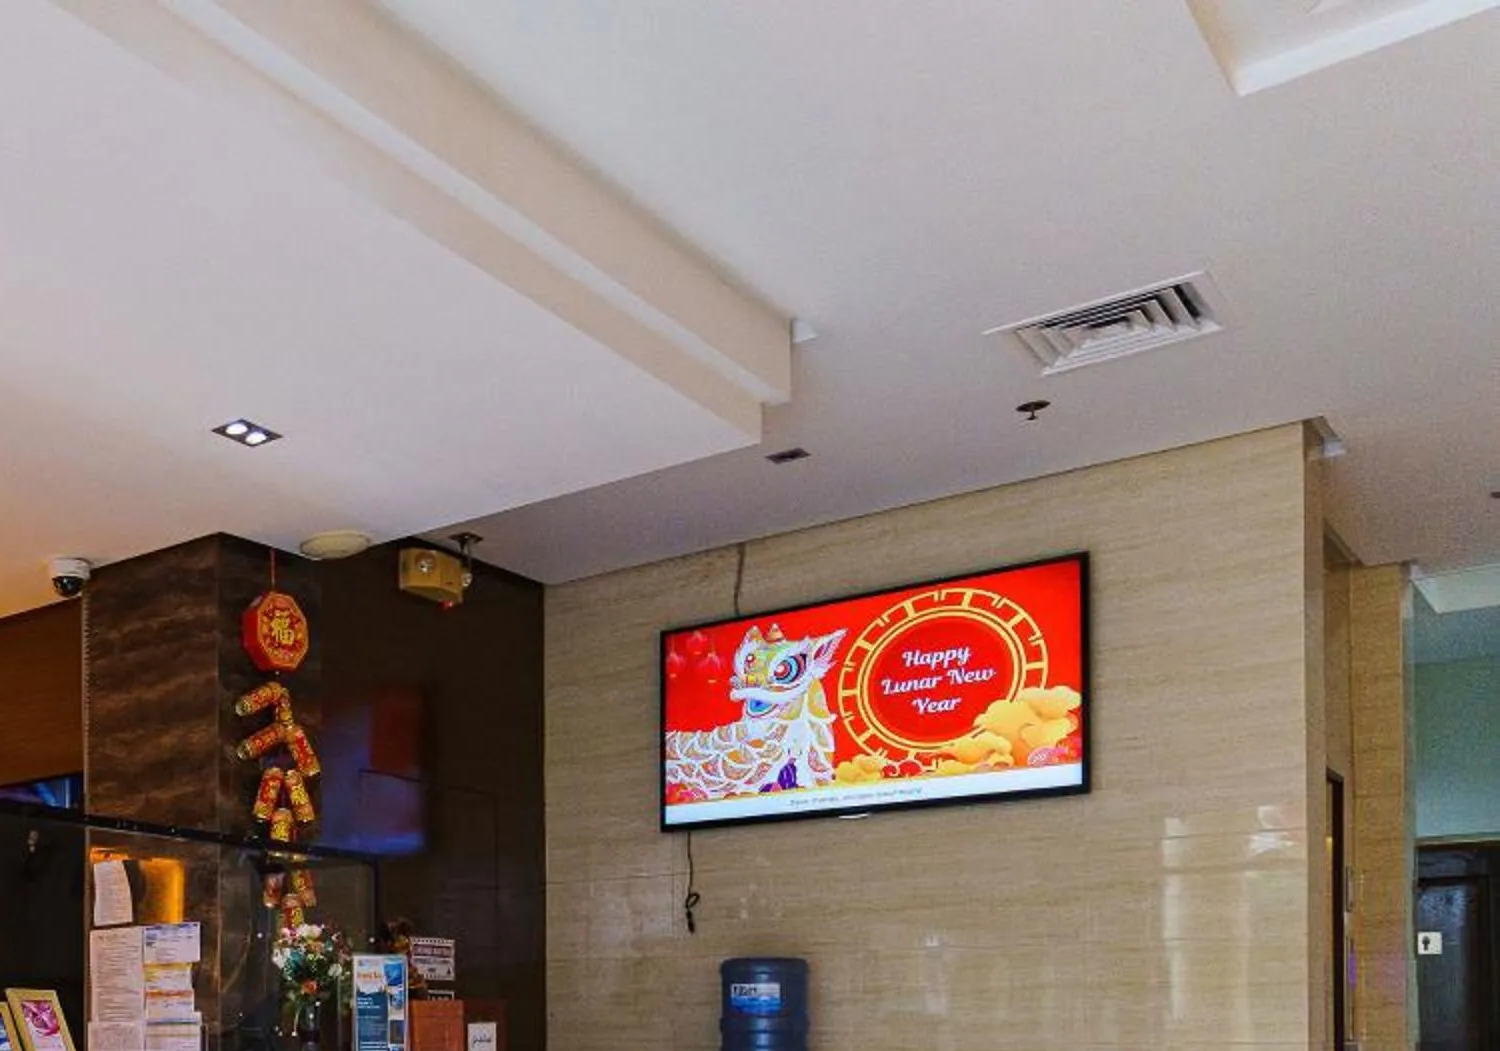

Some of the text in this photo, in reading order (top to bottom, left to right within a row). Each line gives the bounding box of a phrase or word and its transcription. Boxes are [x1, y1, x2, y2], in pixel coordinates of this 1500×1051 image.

[902, 647, 971, 670] Happy
[881, 667, 996, 695] Lunar New
[912, 697, 962, 715] Year
